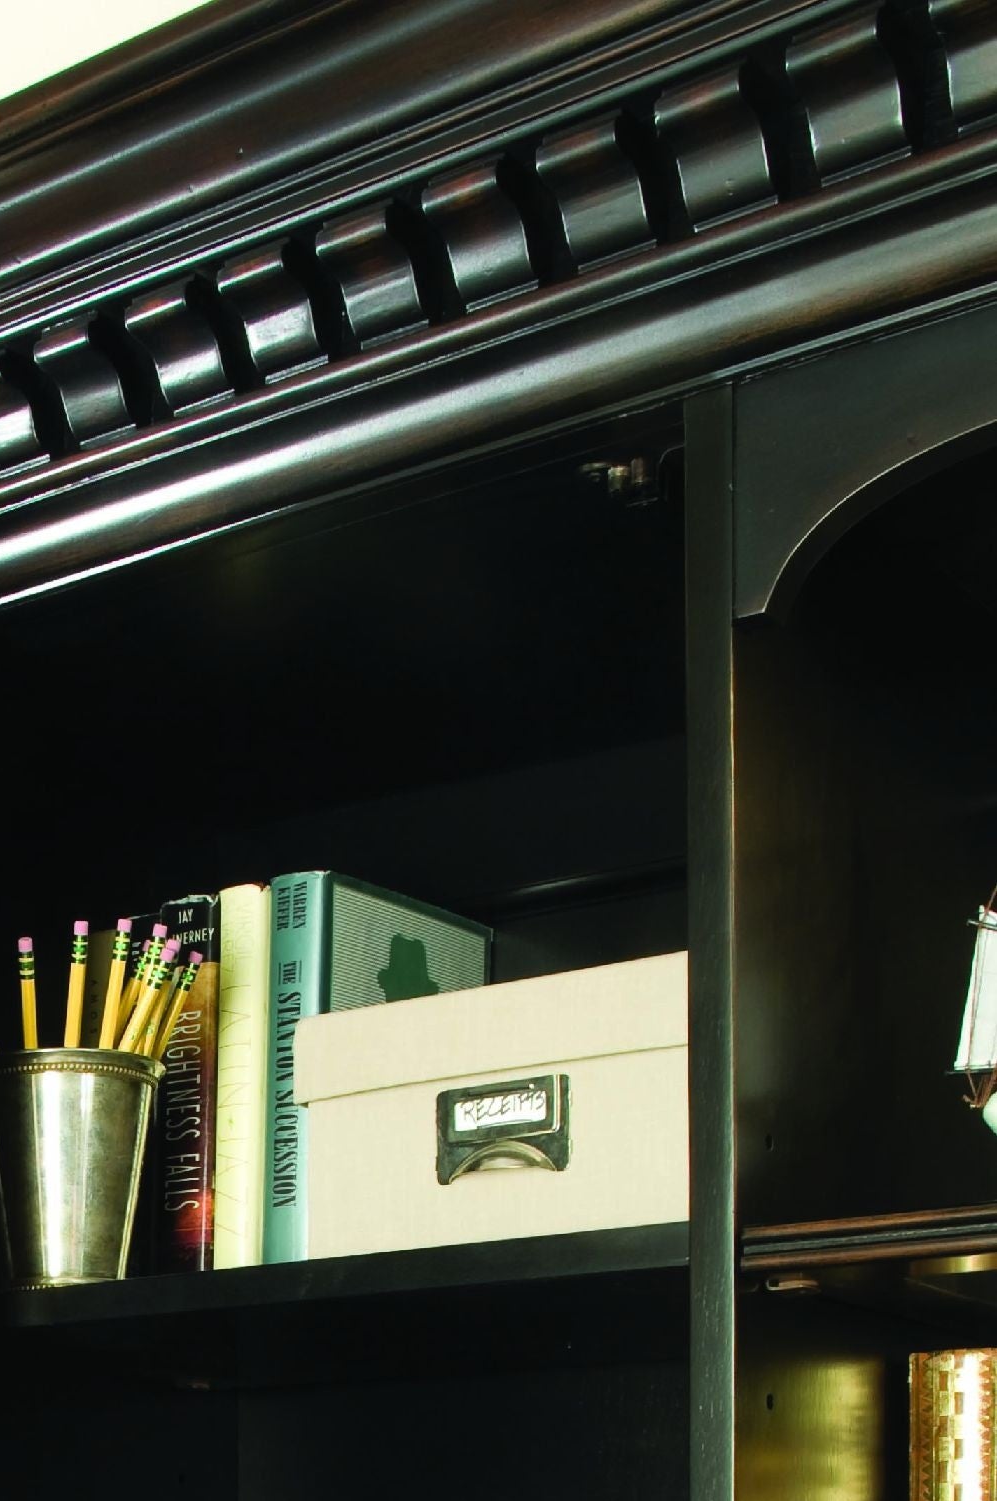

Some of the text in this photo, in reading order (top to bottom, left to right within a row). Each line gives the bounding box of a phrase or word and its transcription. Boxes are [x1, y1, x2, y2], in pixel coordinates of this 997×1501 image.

[178, 908, 194, 924] JAY
[276, 887, 291, 931] KIEFER
[292, 881, 308, 930] WARREN
[281, 961, 298, 985] THE
[163, 1009, 201, 1212] BRIGHTNESS FALLS
[461, 1090, 546, 1124] RECEIPTS
[272, 1088, 299, 1208] SUCCESSION
